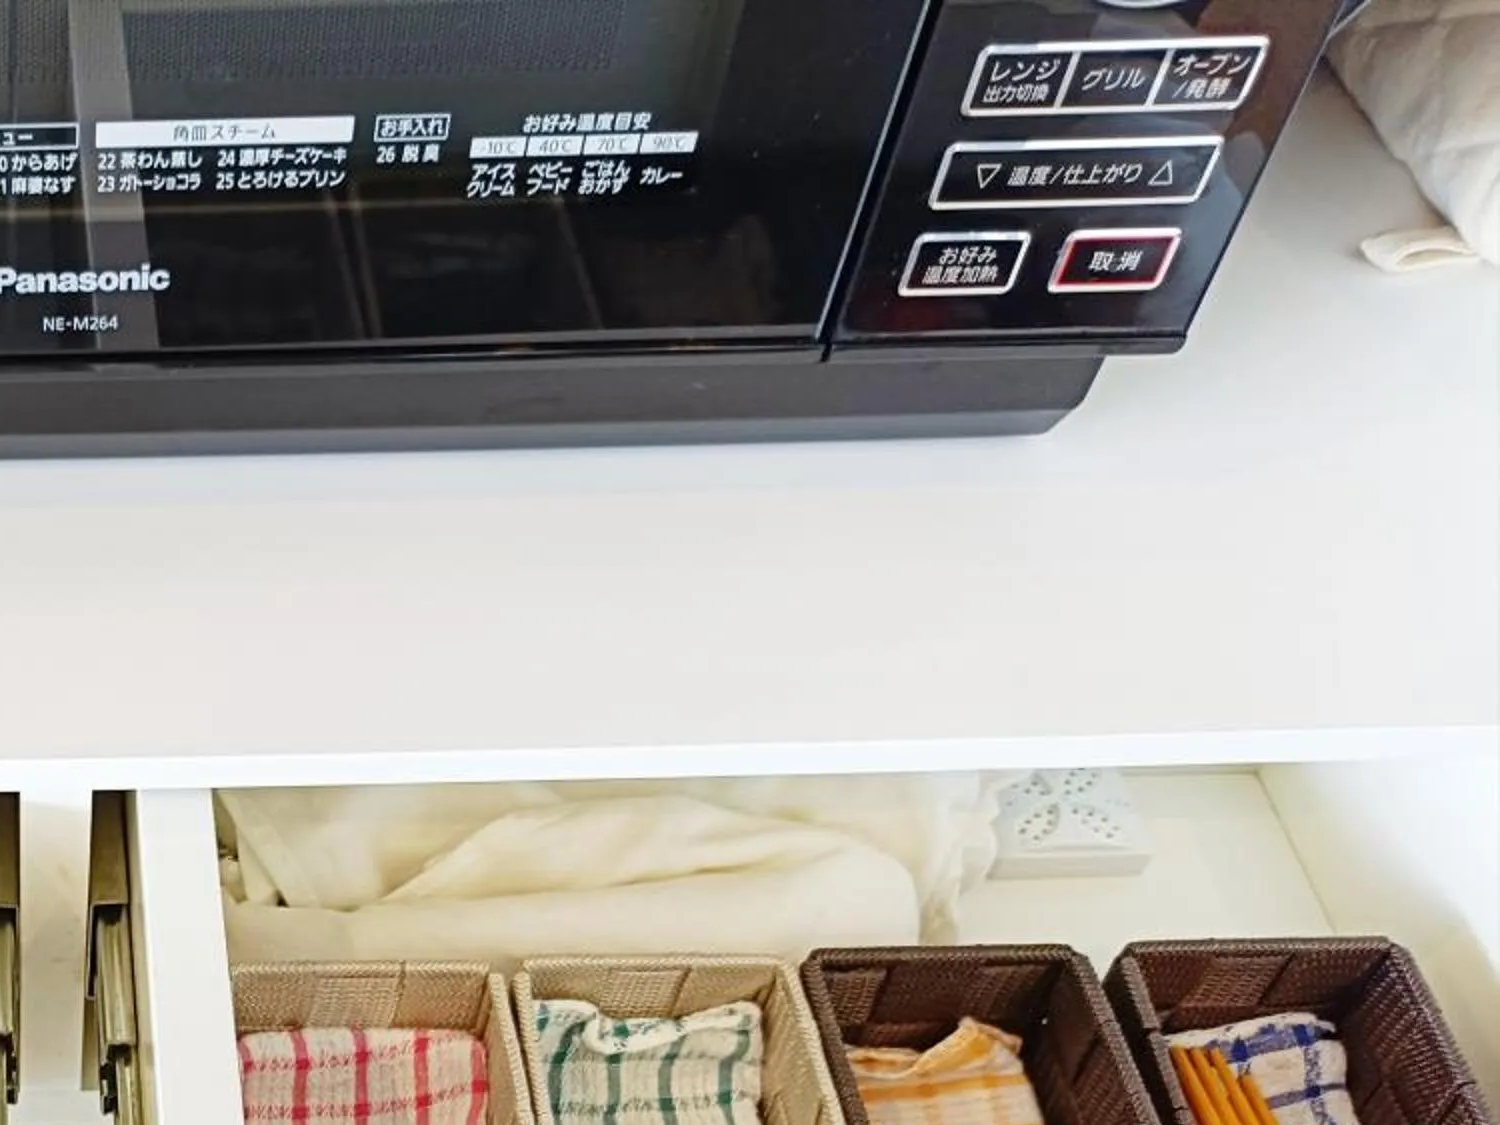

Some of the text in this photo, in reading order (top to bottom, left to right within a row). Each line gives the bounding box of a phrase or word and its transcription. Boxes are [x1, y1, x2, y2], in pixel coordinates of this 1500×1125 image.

[989, 57, 1061, 83] レンジ
[1172, 53, 1252, 76] オーブン
[1082, 68, 1146, 91] グリル
[982, 84, 1049, 104] 出力切換
[379, 119, 445, 138] お手入れ
[522, 112, 652, 134] お好み温度目安
[11, 153, 78, 172] からあげ
[98, 153, 116, 170] 22
[217, 148, 346, 167] 24 濃厚チーズケーキ
[376, 147, 395, 164] 26
[470, 162, 516, 181] アイス
[527, 160, 574, 178] ベビー
[580, 159, 632, 178] ごはん
[638, 167, 685, 186] カレー
[1007, 164, 1143, 188] 温度/仕上がり
[97, 172, 202, 193] 23 ガトーショコラ
[216, 170, 346, 191] 25 とろけるプリン
[465, 181, 516, 199] クリーム
[526, 178, 572, 196] フード
[577, 176, 631, 195] おかず
[938, 244, 999, 265] お好み
[1087, 251, 1143, 273] 取消
[921, 264, 1001, 285] 温度加熱
[42, 314, 119, 333] NE-M264
